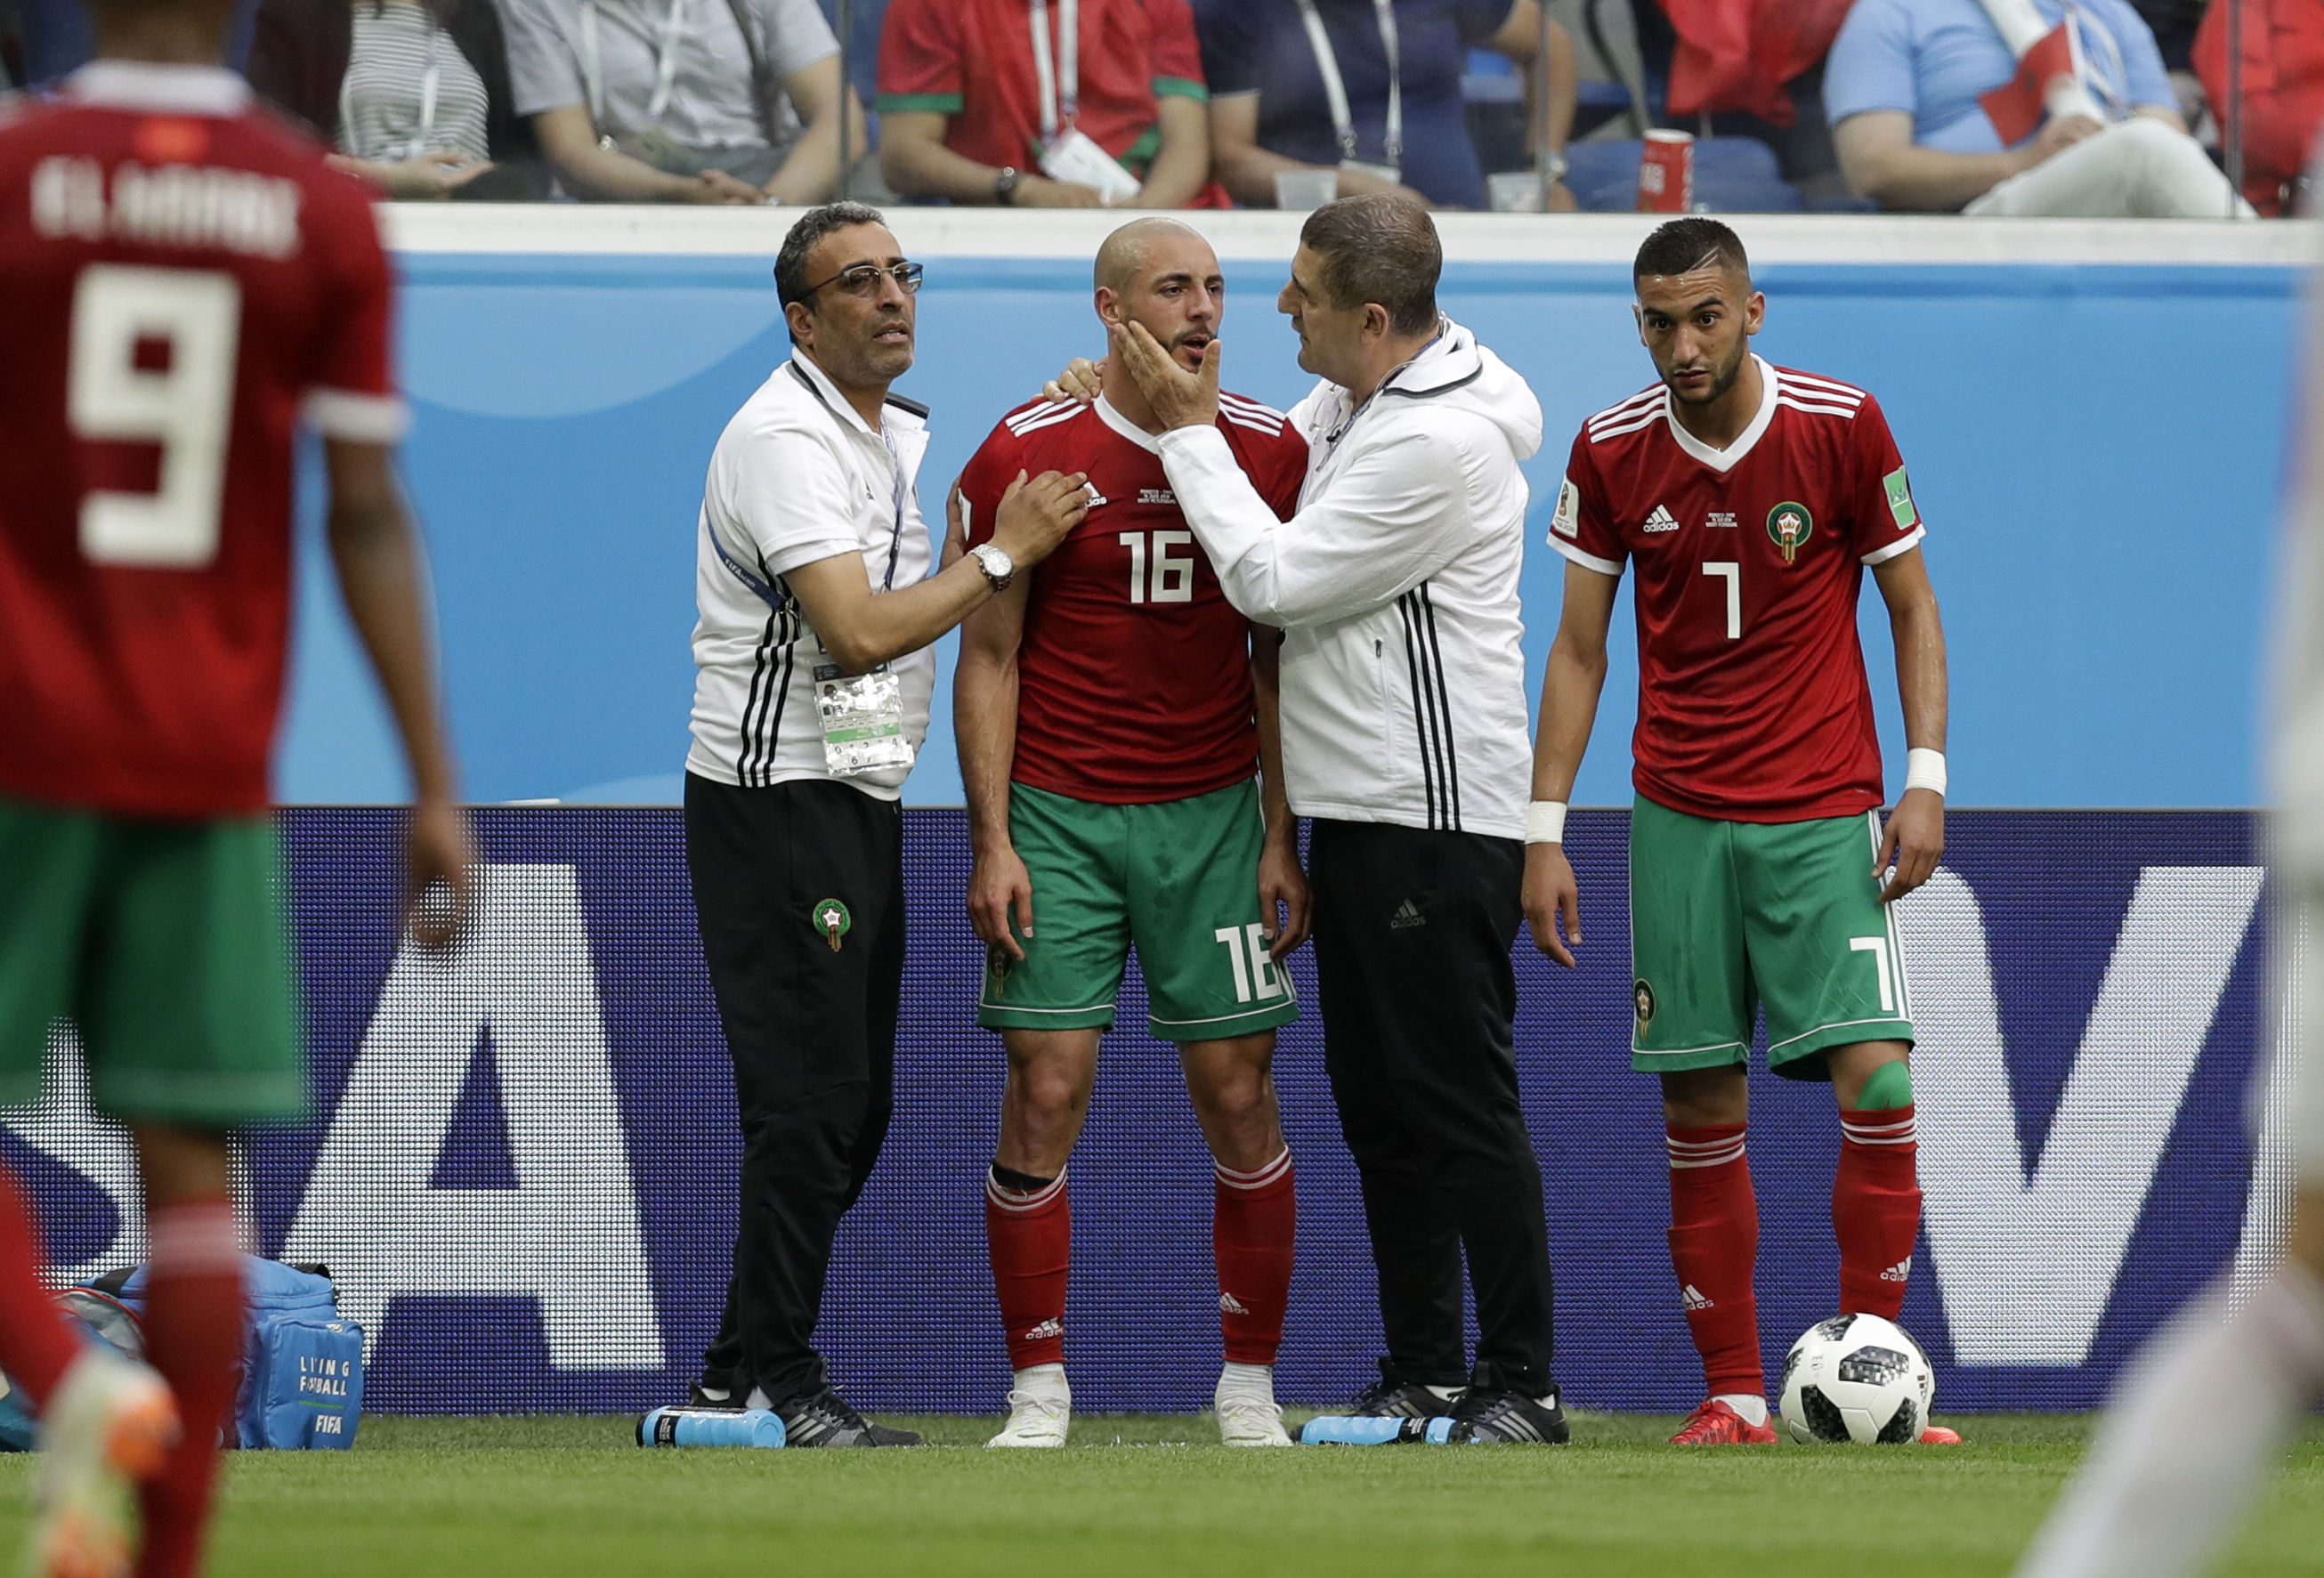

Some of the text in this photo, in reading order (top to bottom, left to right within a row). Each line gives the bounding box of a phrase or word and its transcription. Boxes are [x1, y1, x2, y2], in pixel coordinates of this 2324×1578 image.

[67, 264, 241, 570] 9
[1085, 497, 1107, 507] das
[1642, 521, 1680, 533] adidas
[1119, 530, 1194, 604] 16
[1702, 562, 1741, 639] 7
[1215, 922, 1283, 1003] 16
[1849, 936, 1894, 1012] 7
[1880, 1272, 1908, 1282] adid
[300, 1355, 350, 1377] LIING
[315, 1414, 343, 1435] FIFA
